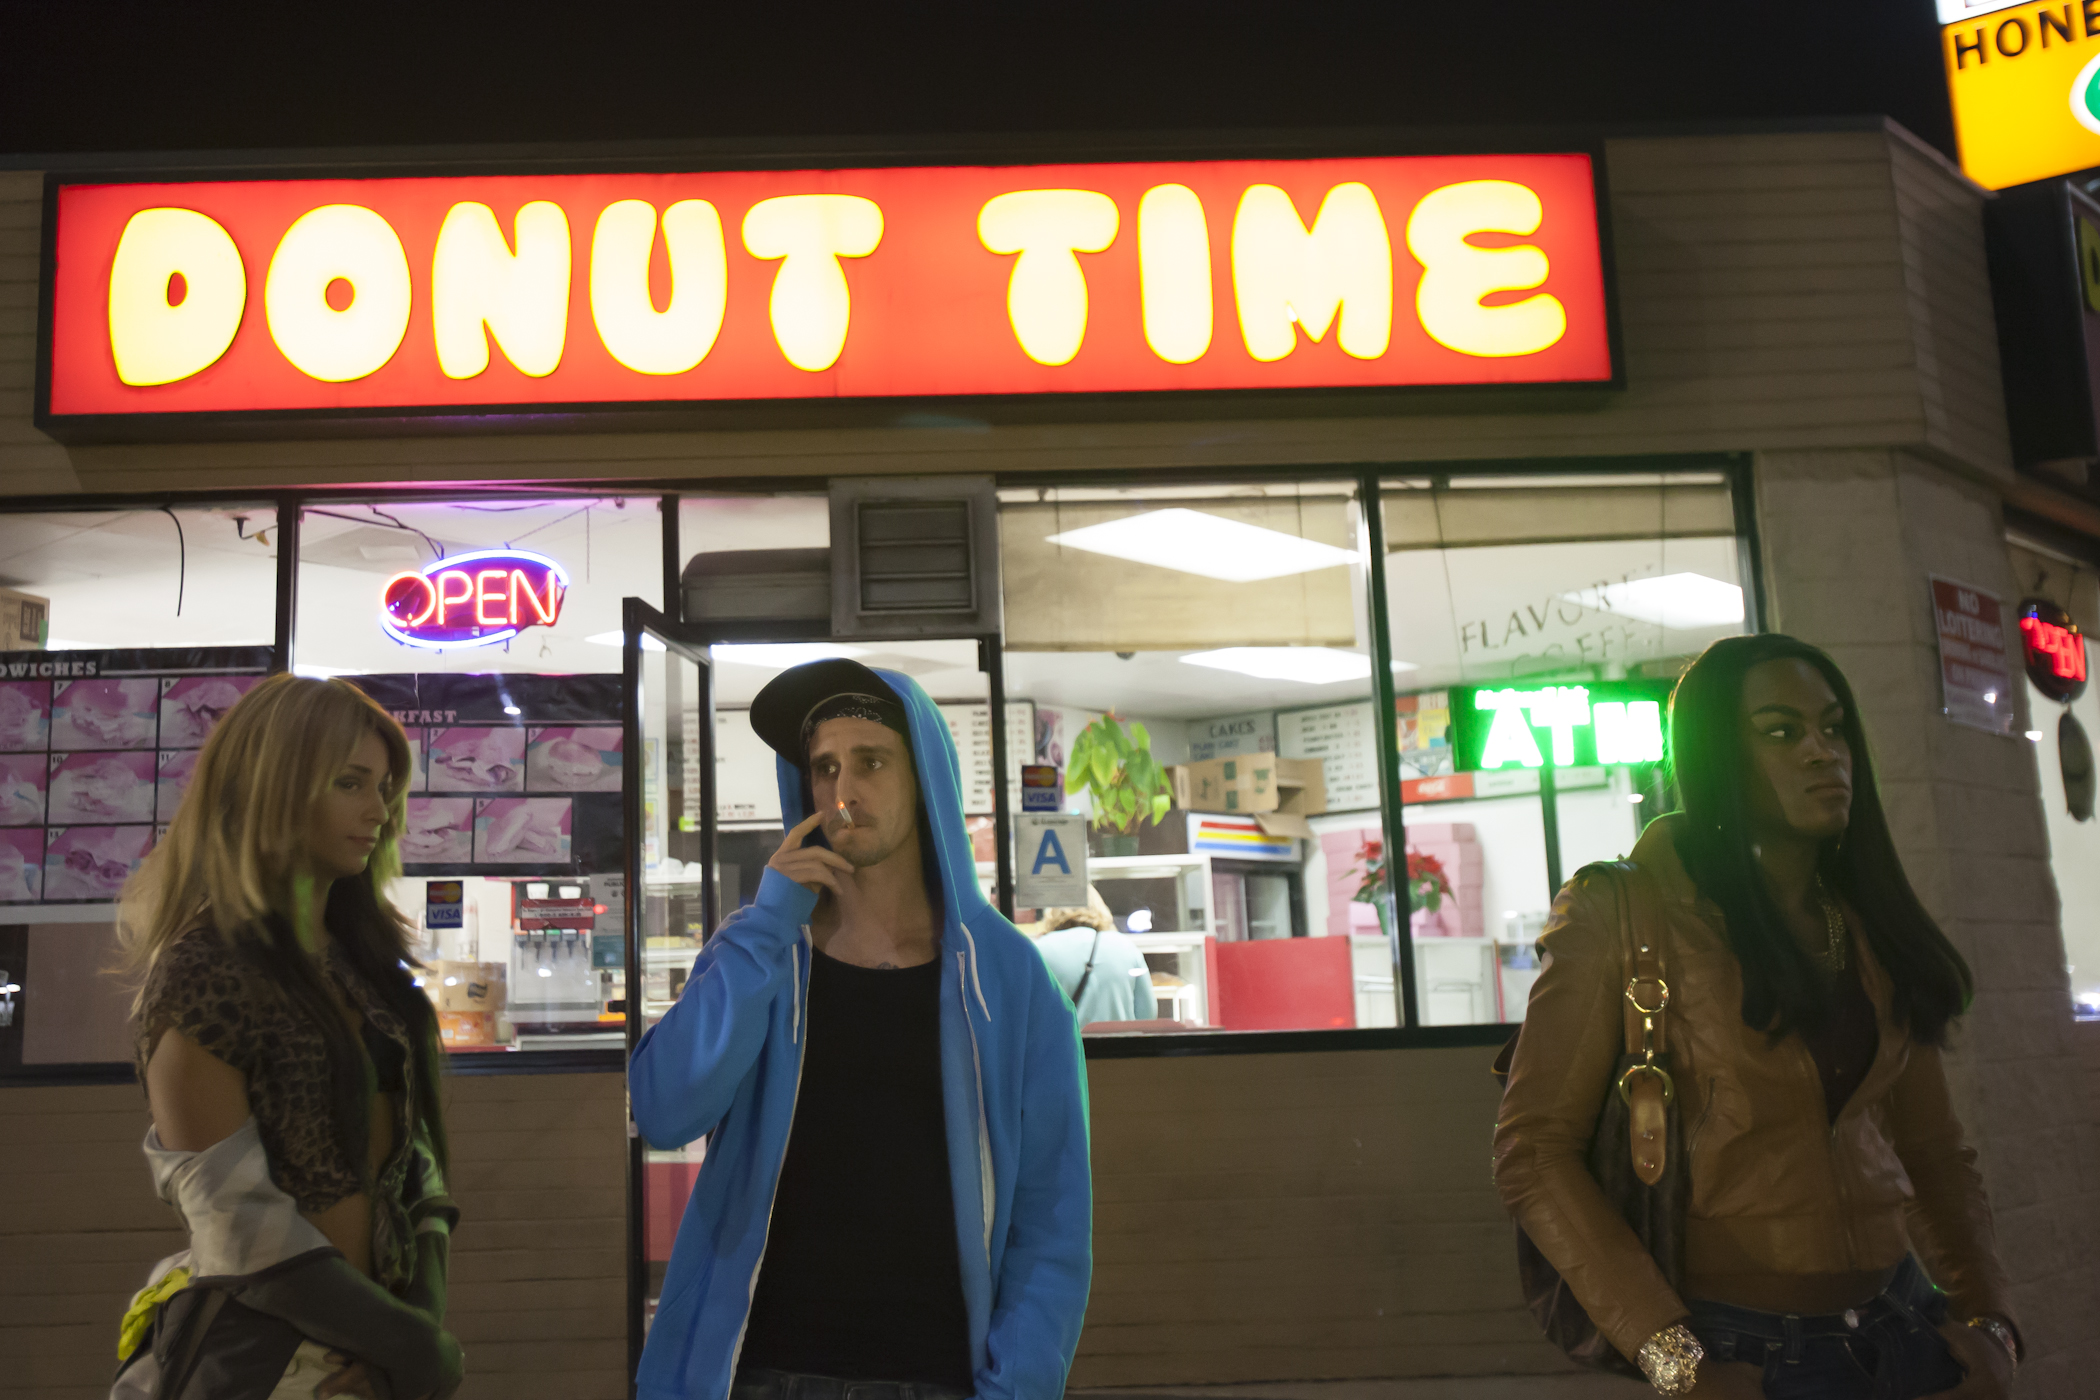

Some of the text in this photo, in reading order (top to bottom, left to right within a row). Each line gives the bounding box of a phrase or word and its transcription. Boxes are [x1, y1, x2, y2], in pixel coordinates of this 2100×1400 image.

[108, 180, 1567, 387] DONUT TIME
[381, 568, 557, 628] OPEN
[1461, 564, 1653, 653] FLAVOR
[392, 710, 457, 724] KFAST
[1480, 701, 1664, 769] ATM
[1027, 791, 1056, 803] VISA
[1031, 828, 1071, 875] A
[431, 908, 461, 920] VISA
